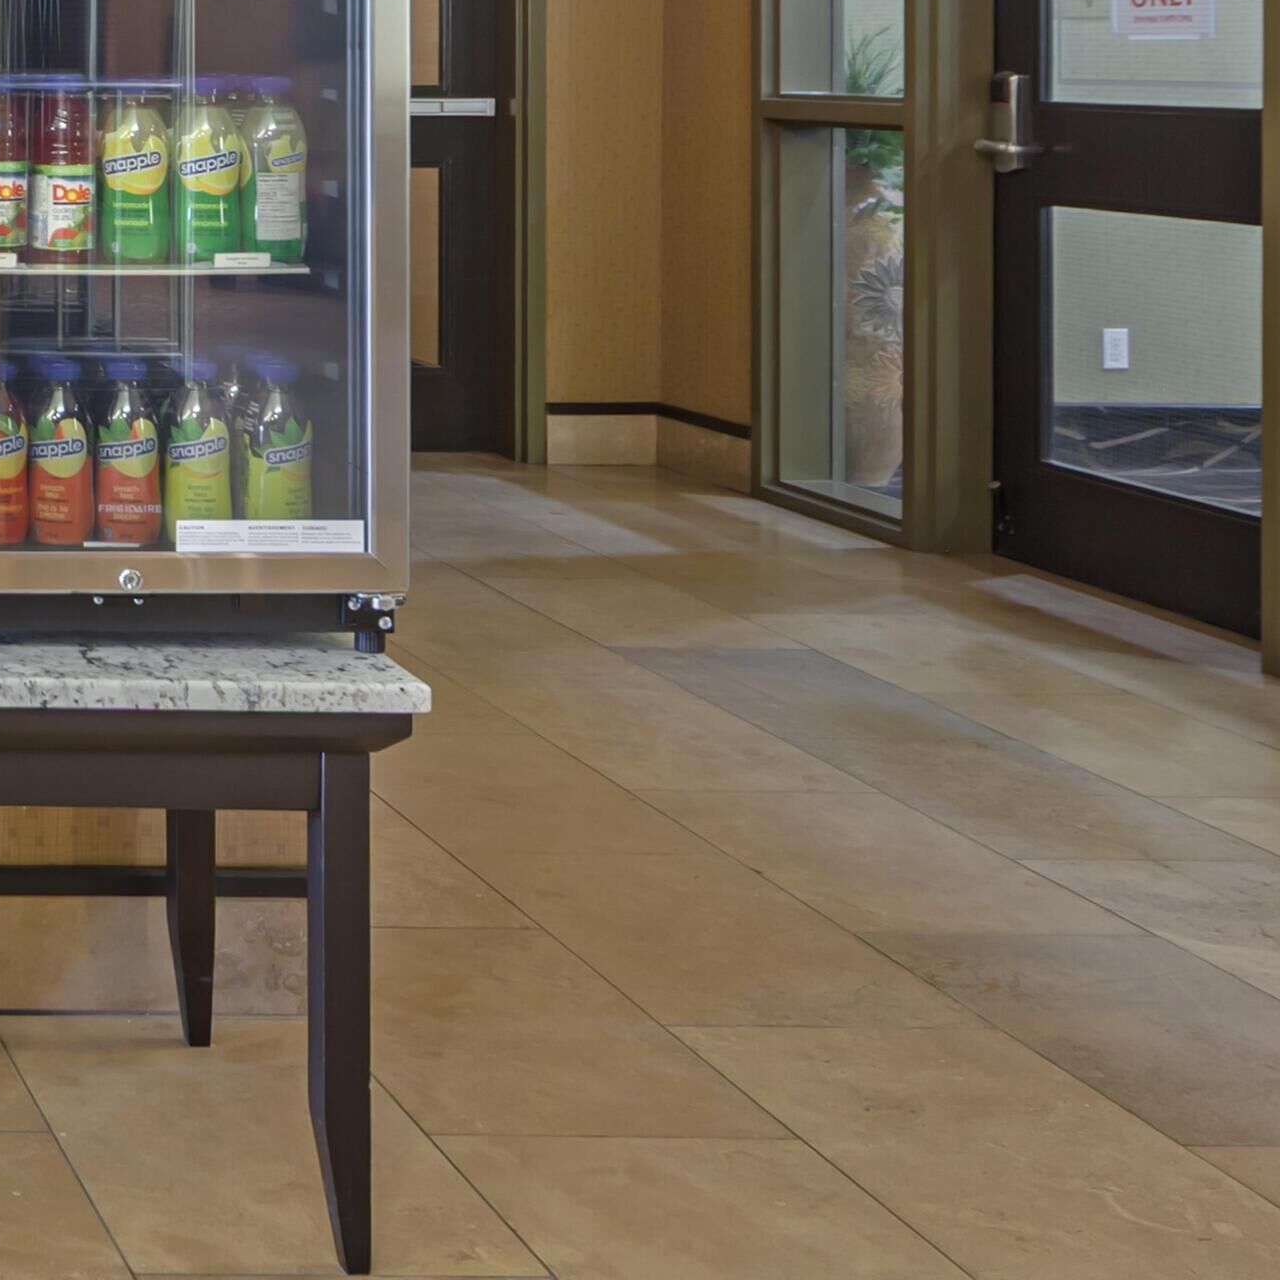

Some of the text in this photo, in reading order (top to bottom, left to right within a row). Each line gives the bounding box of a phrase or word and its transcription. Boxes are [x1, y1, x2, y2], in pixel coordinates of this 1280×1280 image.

[104, 153, 161, 174] snapple
[179, 152, 237, 175] snapple
[52, 183, 90, 202] Dole
[31, 440, 83, 461] napple
[99, 438, 155, 461] snapple
[170, 437, 226, 459] snapple
[98, 503, 162, 514] FRIGIDAIRE
